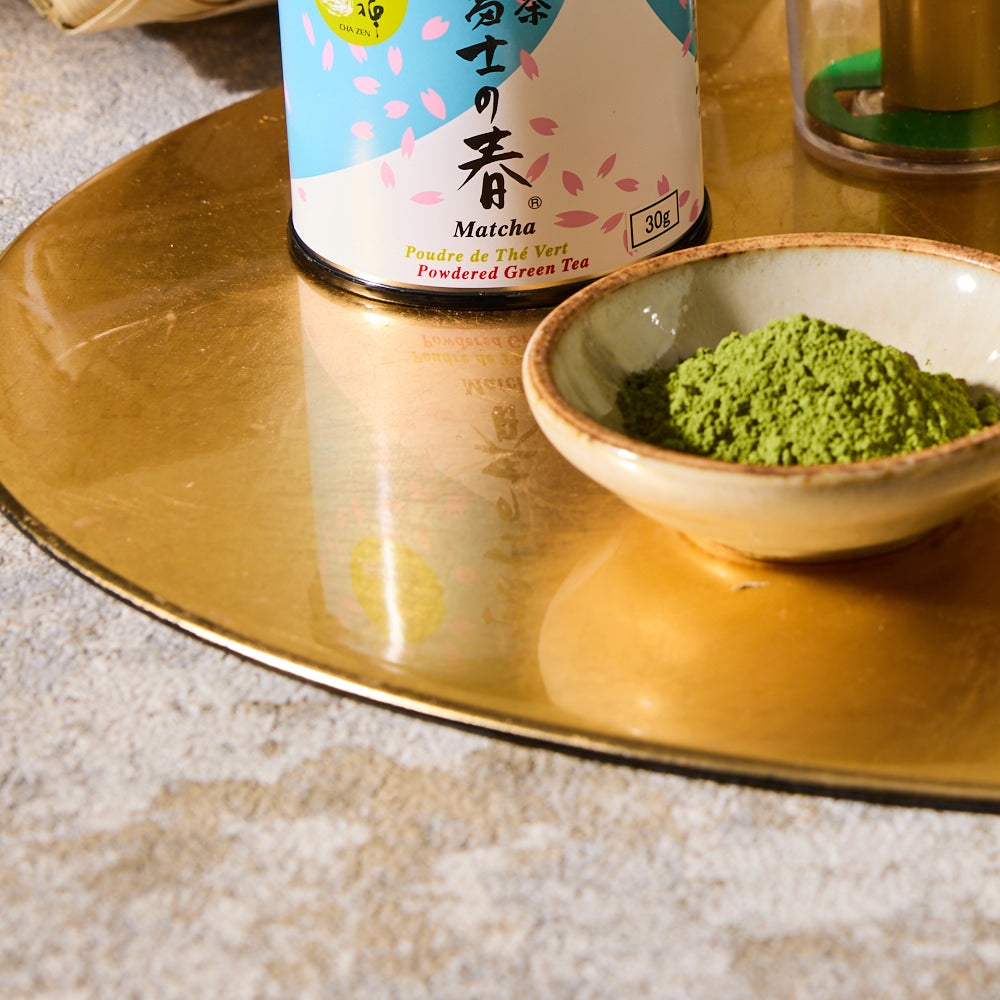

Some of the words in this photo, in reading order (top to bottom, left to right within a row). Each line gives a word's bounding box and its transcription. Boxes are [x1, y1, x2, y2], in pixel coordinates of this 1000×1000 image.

[340, 23, 353, 33] CHA
[355, 27, 370, 36] ZEN
[453, 219, 536, 238] Matcha
[645, 210, 670, 233] 30g
[405, 245, 463, 262] Poudre
[470, 249, 489, 263] de
[495, 245, 528, 262] Thé
[534, 242, 568, 259] Vert
[417, 264, 499, 280] Powdered
[504, 263, 556, 280] Green
[561, 257, 590, 273] Tea
